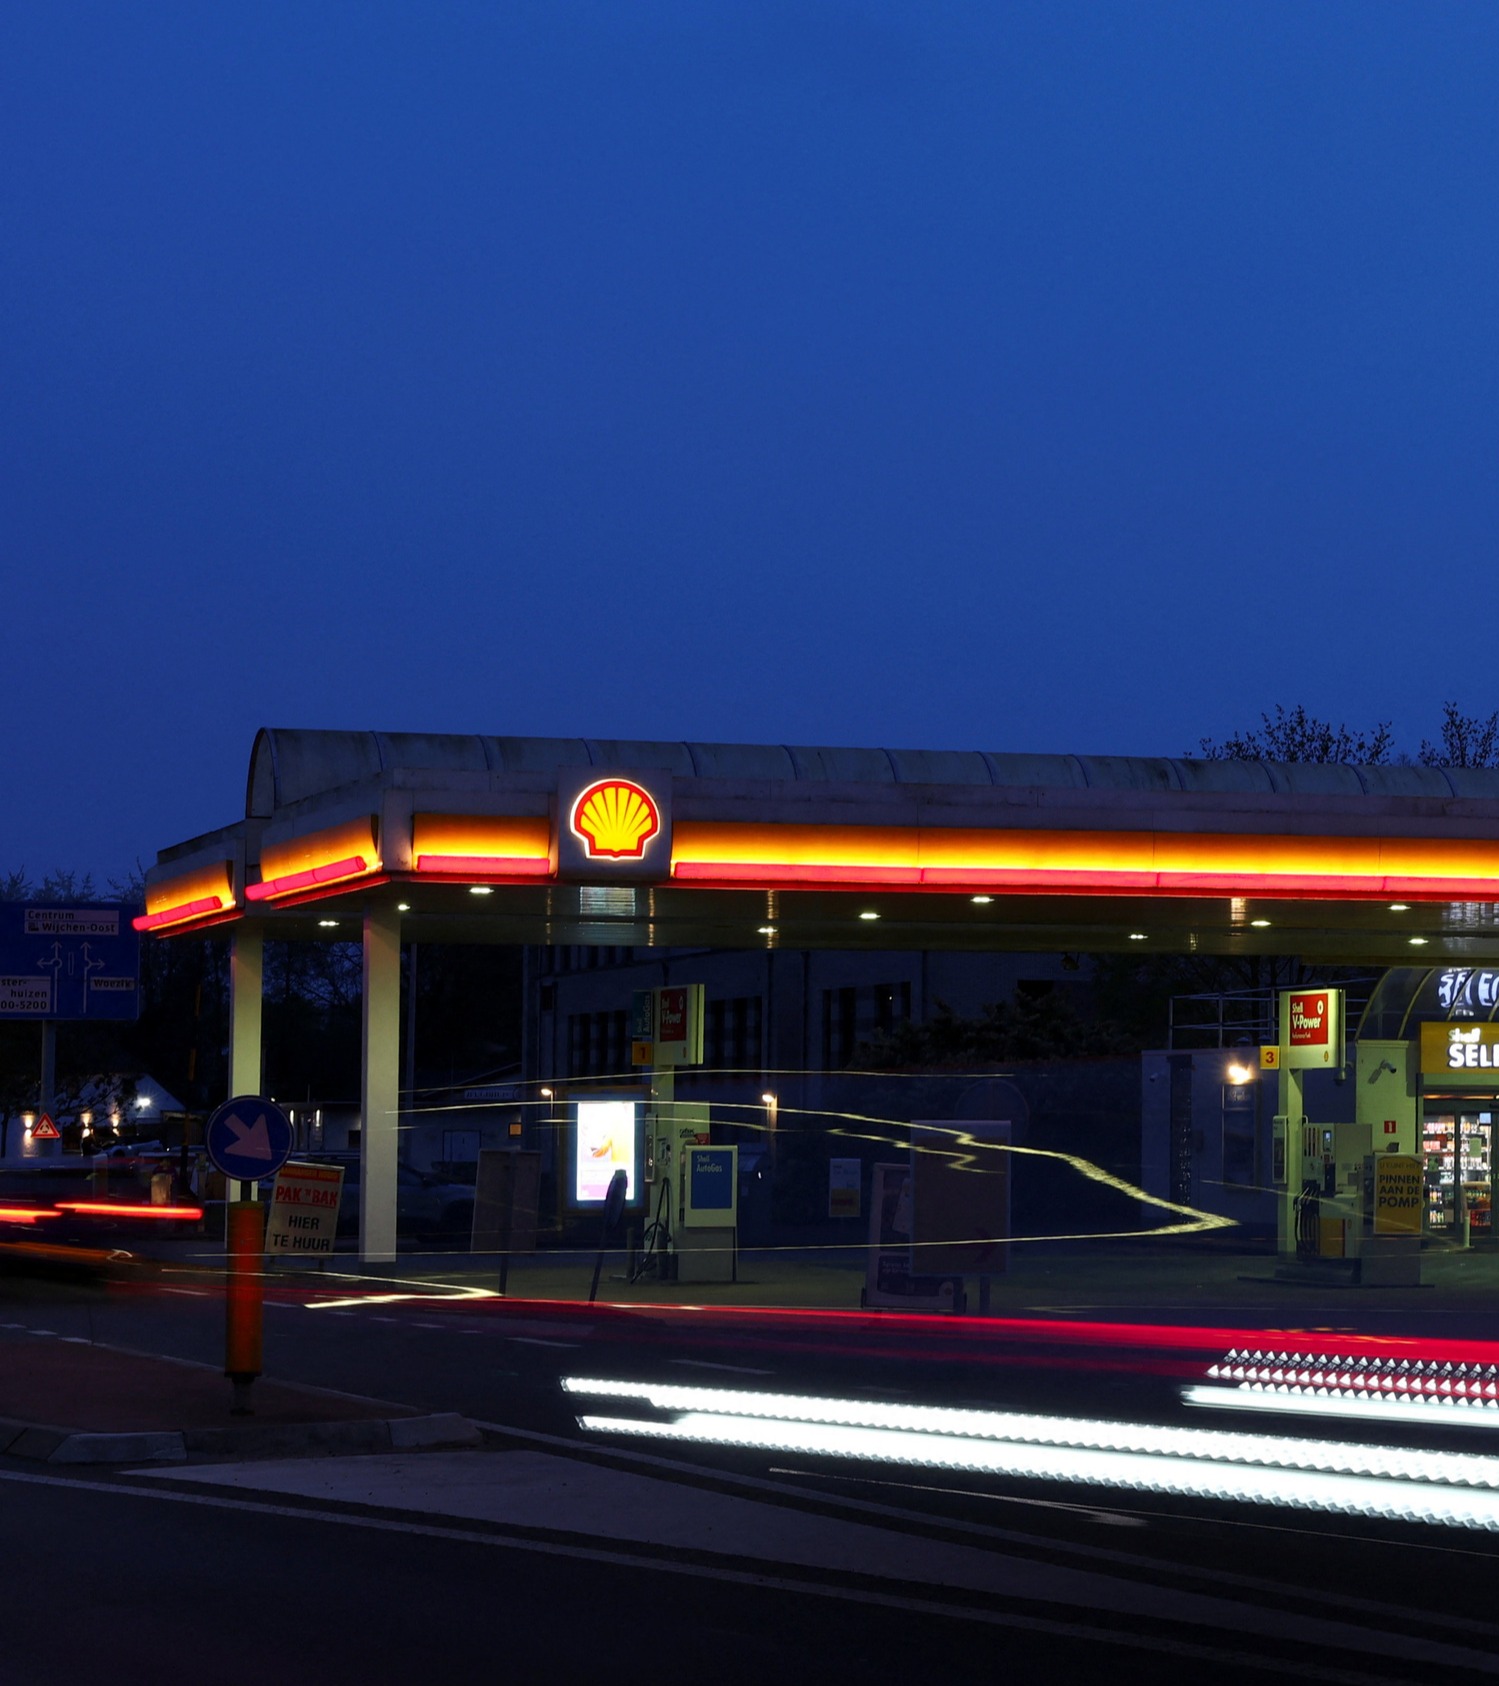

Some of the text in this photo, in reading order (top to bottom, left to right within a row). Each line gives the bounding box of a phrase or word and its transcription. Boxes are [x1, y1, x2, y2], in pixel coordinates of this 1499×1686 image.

[28, 911, 75, 920] Centrum
[42, 923, 115, 933] Wijchen-Oost
[10, 989, 47, 998] huizen
[1292, 1002, 1304, 1014] Shell
[1292, 1014, 1322, 1030] V-Power
[1265, 1051, 1275, 1064] 3
[1379, 1175, 1420, 1184] PINNEN
[276, 1186, 302, 1201] PAK
[312, 1189, 338, 1206] BAK
[1380, 1186, 1420, 1195] AAN DE
[1379, 1197, 1419, 1208] POMP
[288, 1216, 320, 1230] HIER
[273, 1233, 330, 1251] TE HUUR
